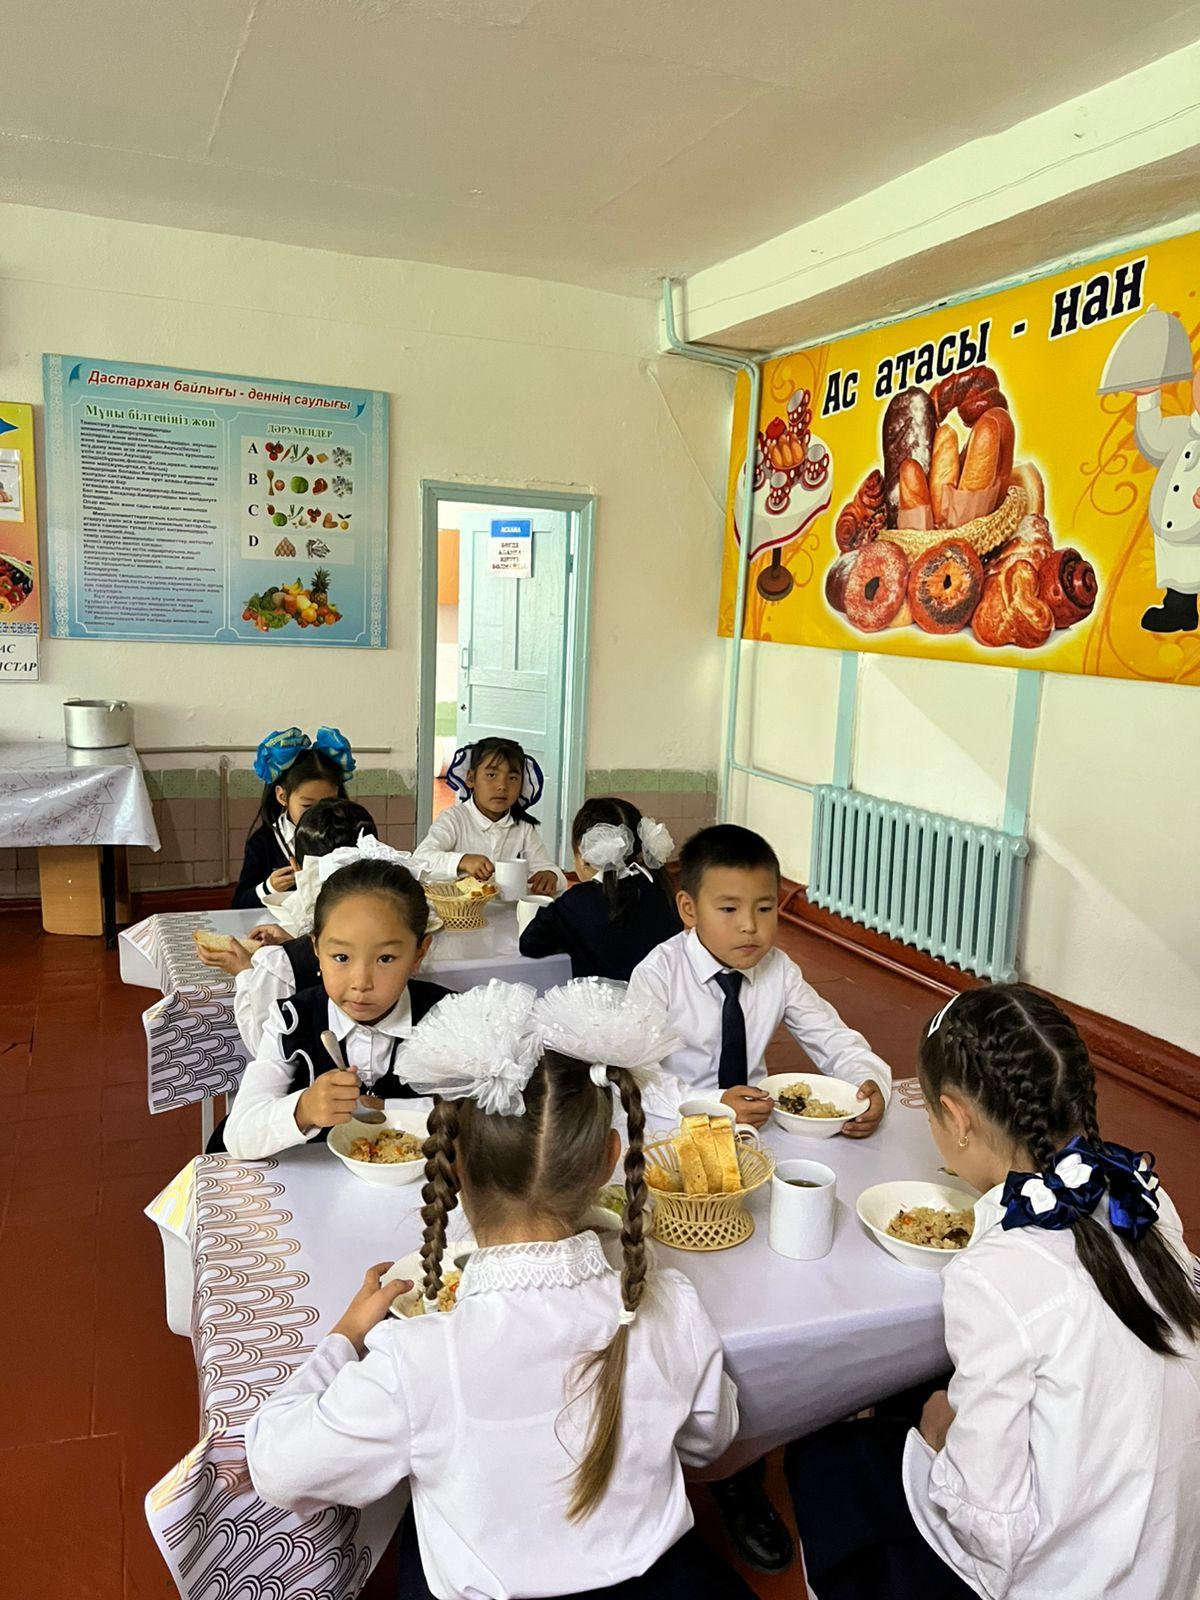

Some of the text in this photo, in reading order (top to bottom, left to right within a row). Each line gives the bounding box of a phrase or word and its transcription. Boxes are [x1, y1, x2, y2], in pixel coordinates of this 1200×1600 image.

[822, 371, 858, 416] Ас
[875, 321, 990, 397] атасы
[1050, 260, 1146, 338] нан
[88, 370, 170, 390] Дастархан
[173, 380, 237, 398] байлығы
[248, 388, 291, 405] деннің
[294, 395, 351, 410] саулығы
[248, 535, 259, 547] D
